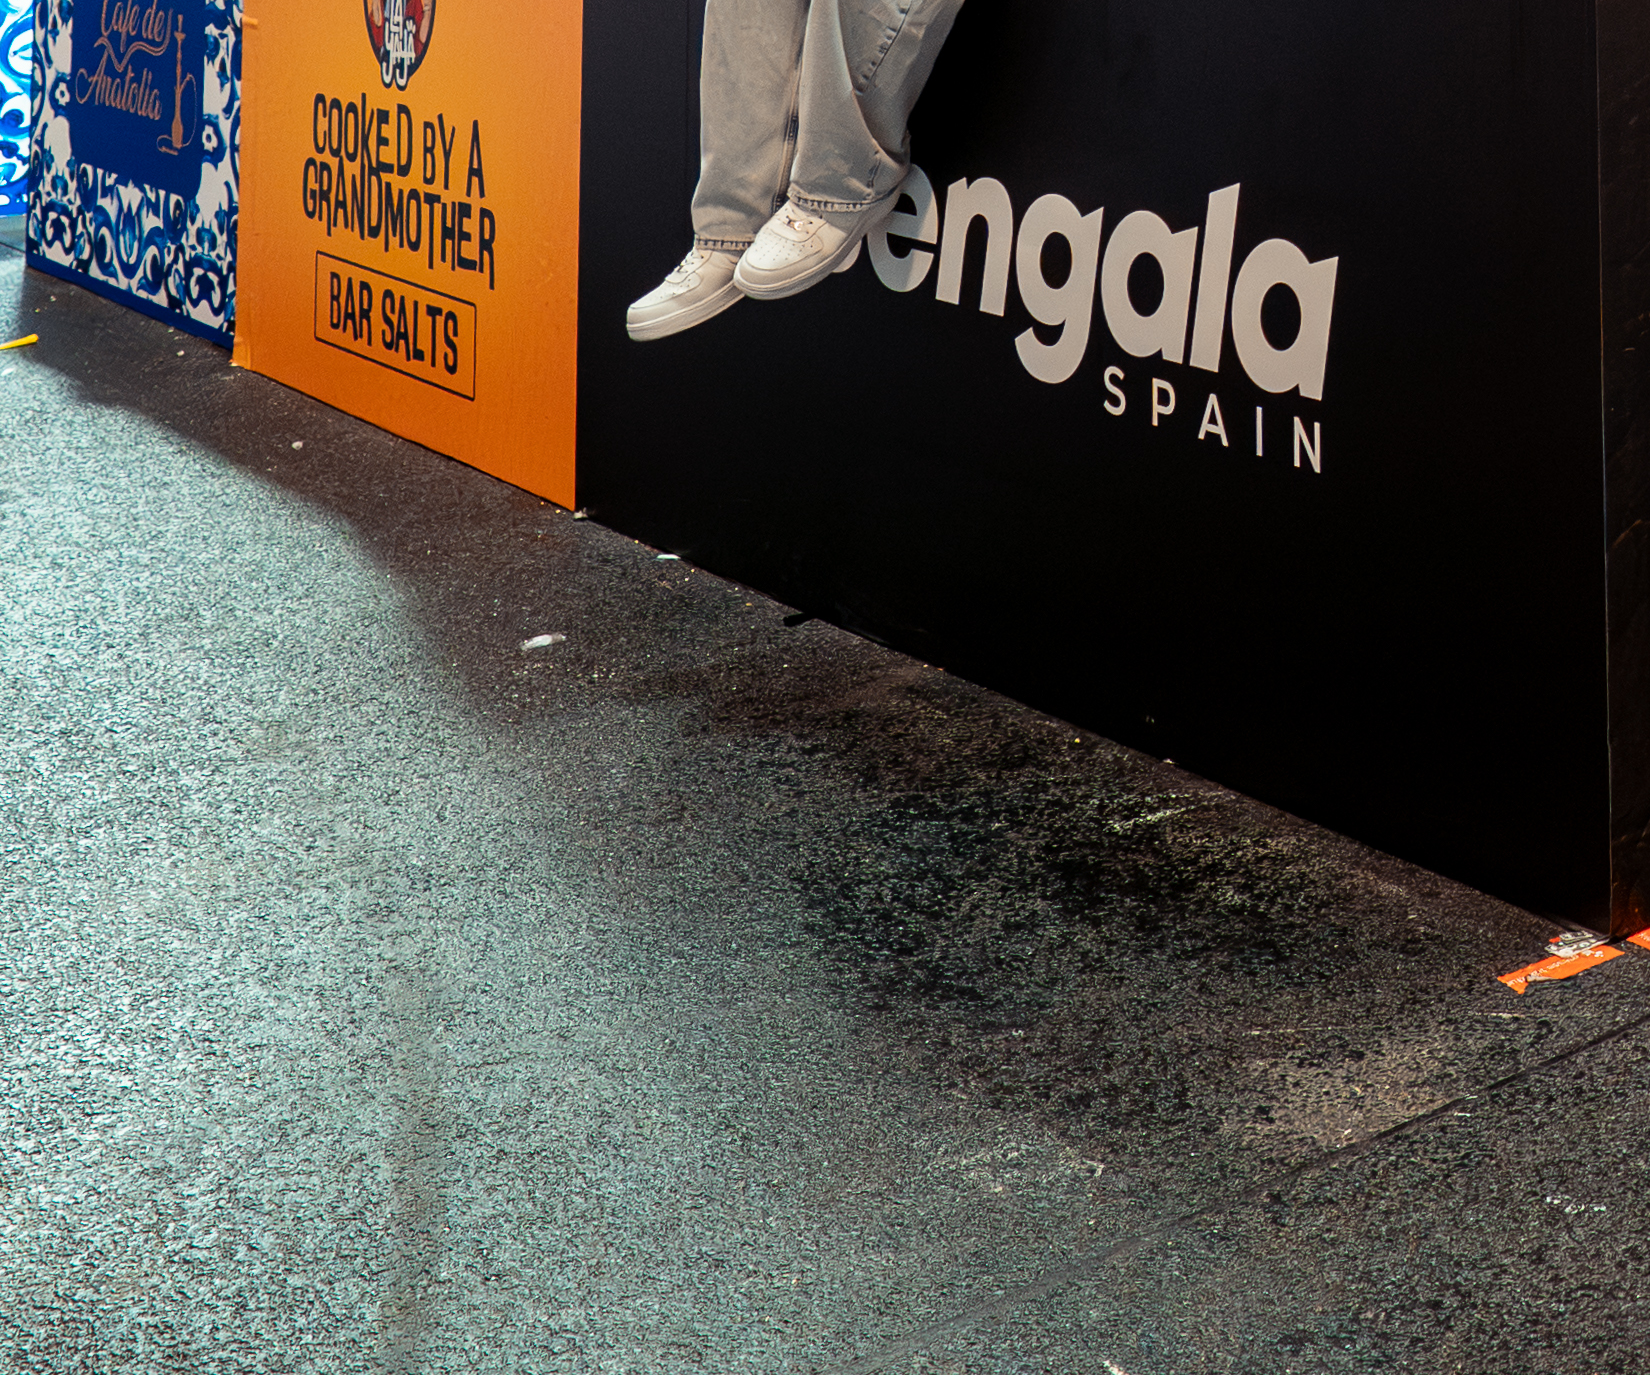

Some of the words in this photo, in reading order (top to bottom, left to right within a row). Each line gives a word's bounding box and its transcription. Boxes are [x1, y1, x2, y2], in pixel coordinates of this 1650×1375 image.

[313, 92, 412, 178] COOKED
[423, 113, 456, 191] BY
[465, 119, 487, 200] A
[302, 158, 496, 291] GRANDMOTHER
[328, 271, 373, 347] BAR
[381, 293, 459, 376] SALTS
[829, 163, 1339, 401] engala
[1103, 365, 1321, 473] SPAIN
